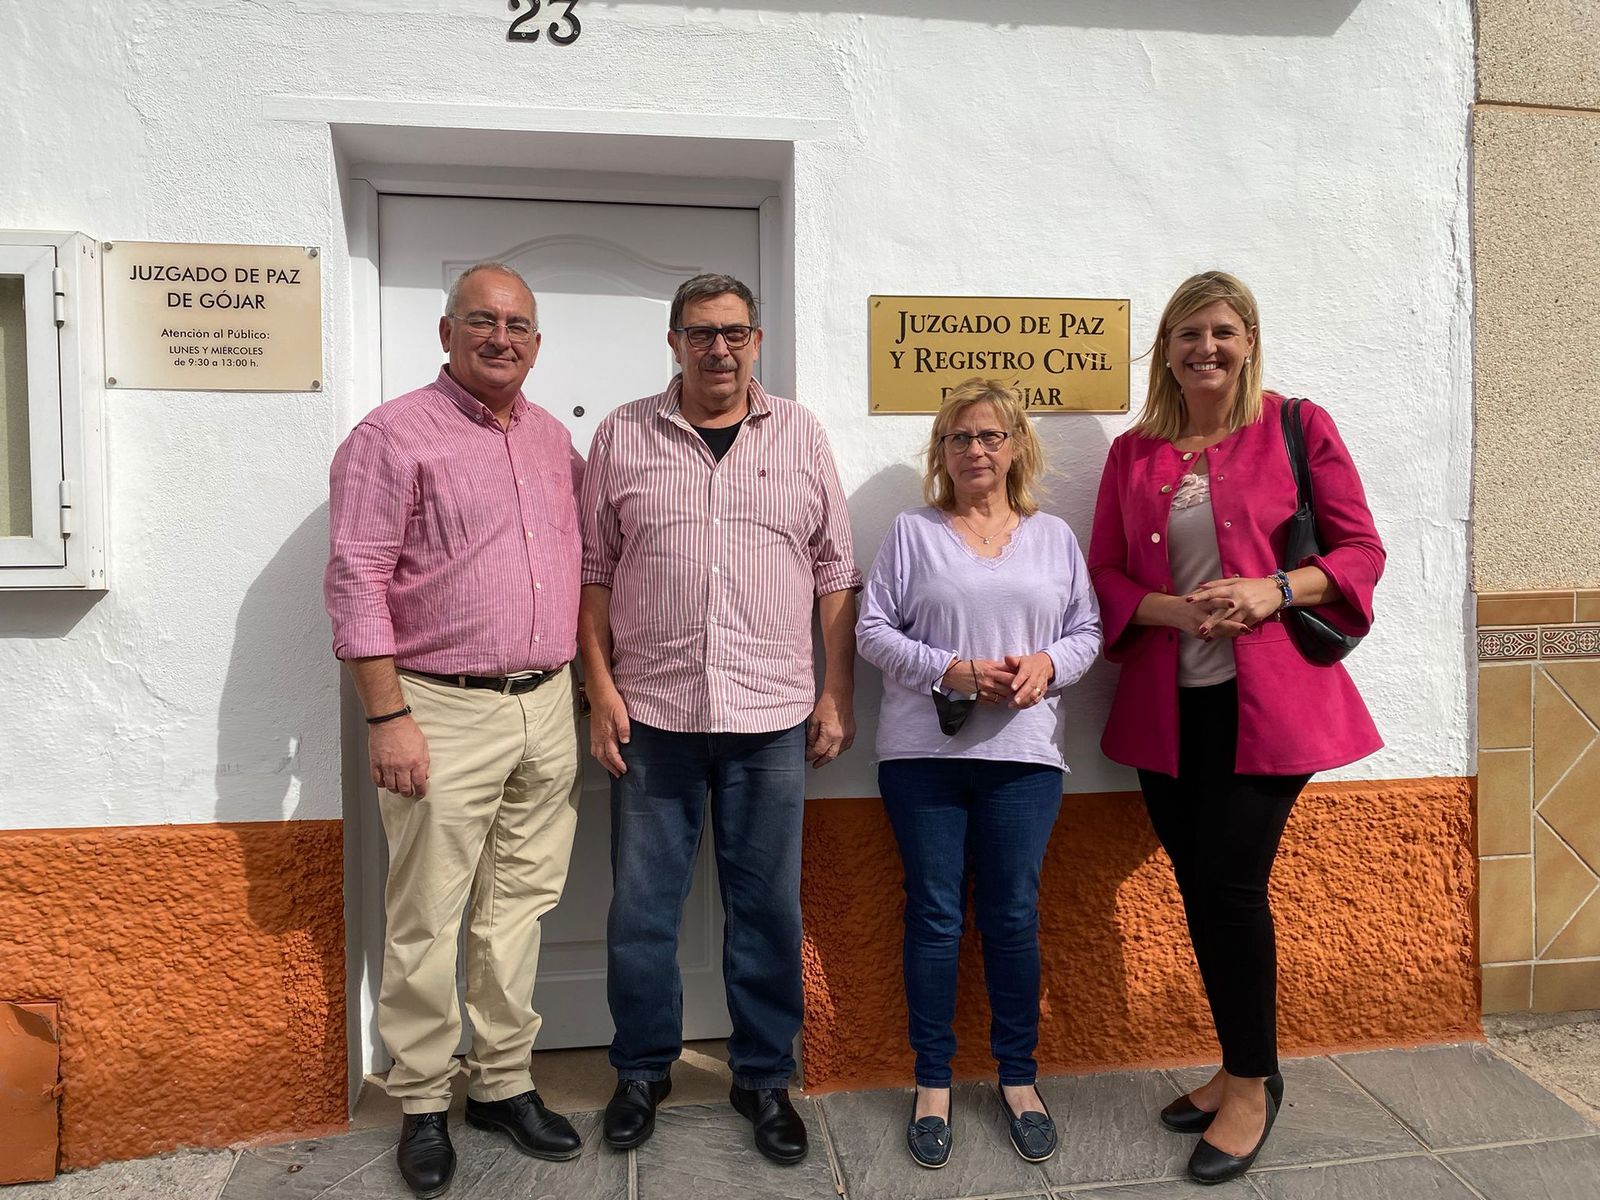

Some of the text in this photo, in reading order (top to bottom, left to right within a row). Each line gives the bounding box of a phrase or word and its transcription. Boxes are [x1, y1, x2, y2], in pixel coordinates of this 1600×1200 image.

[508, 0, 581, 44] 23
[130, 265, 301, 284] JUZGADO DE PAZ
[167, 290, 266, 309] DE GÓJAR
[160, 328, 270, 339] Atención al Público:
[169, 346, 200, 354] LUNES
[211, 345, 264, 355] MIÉRCOLES
[174, 358, 186, 366] de
[188, 358, 209, 367] 9:30
[221, 359, 248, 367] 13:00
[250, 359, 259, 367] h.
